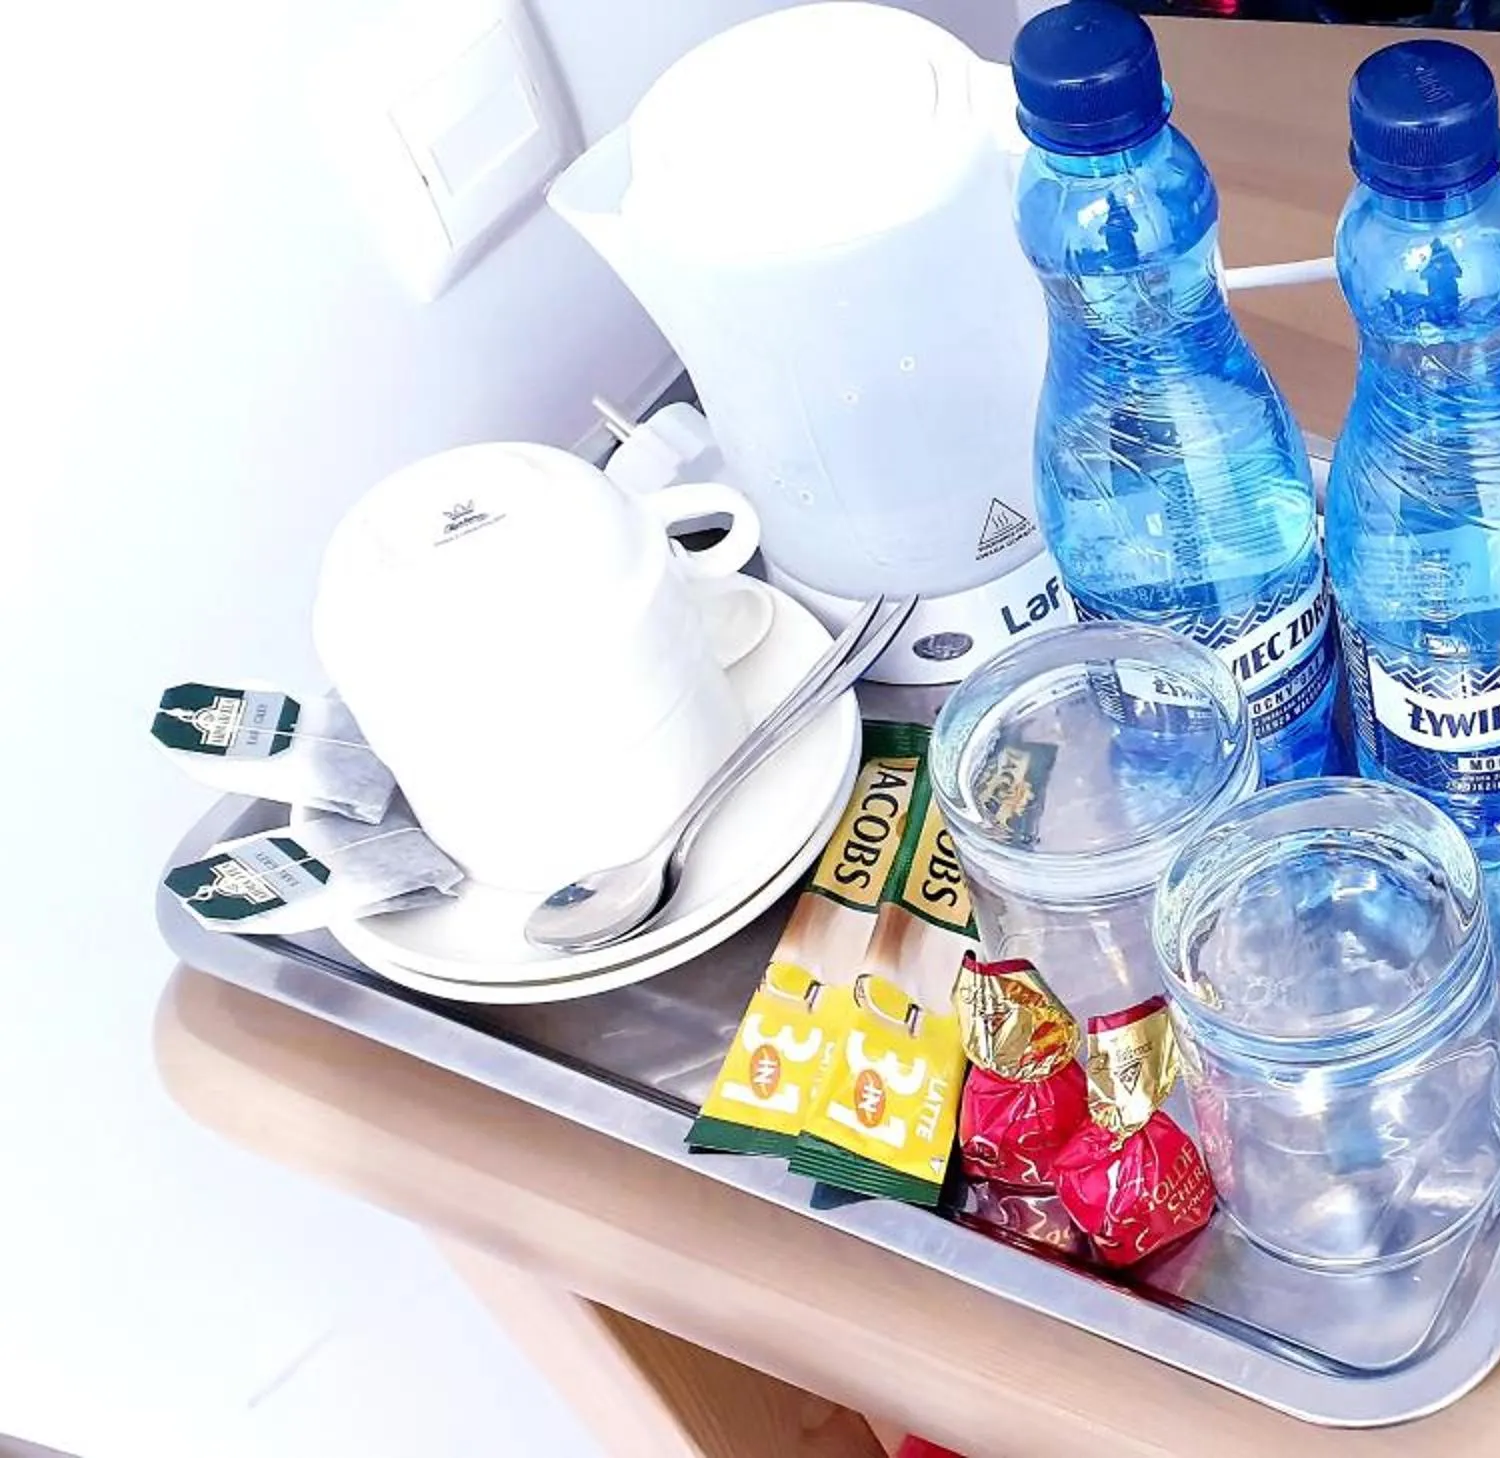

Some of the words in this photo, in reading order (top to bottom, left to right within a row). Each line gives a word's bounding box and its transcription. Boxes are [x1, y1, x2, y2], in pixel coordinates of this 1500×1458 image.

[834, 762, 915, 889] JACOBS
[921, 829, 961, 907] OBS
[743, 1013, 823, 1063] 3
[845, 1029, 928, 1096] 3
[826, 1101, 908, 1149] 1
[914, 1075, 951, 1144] LATTE
